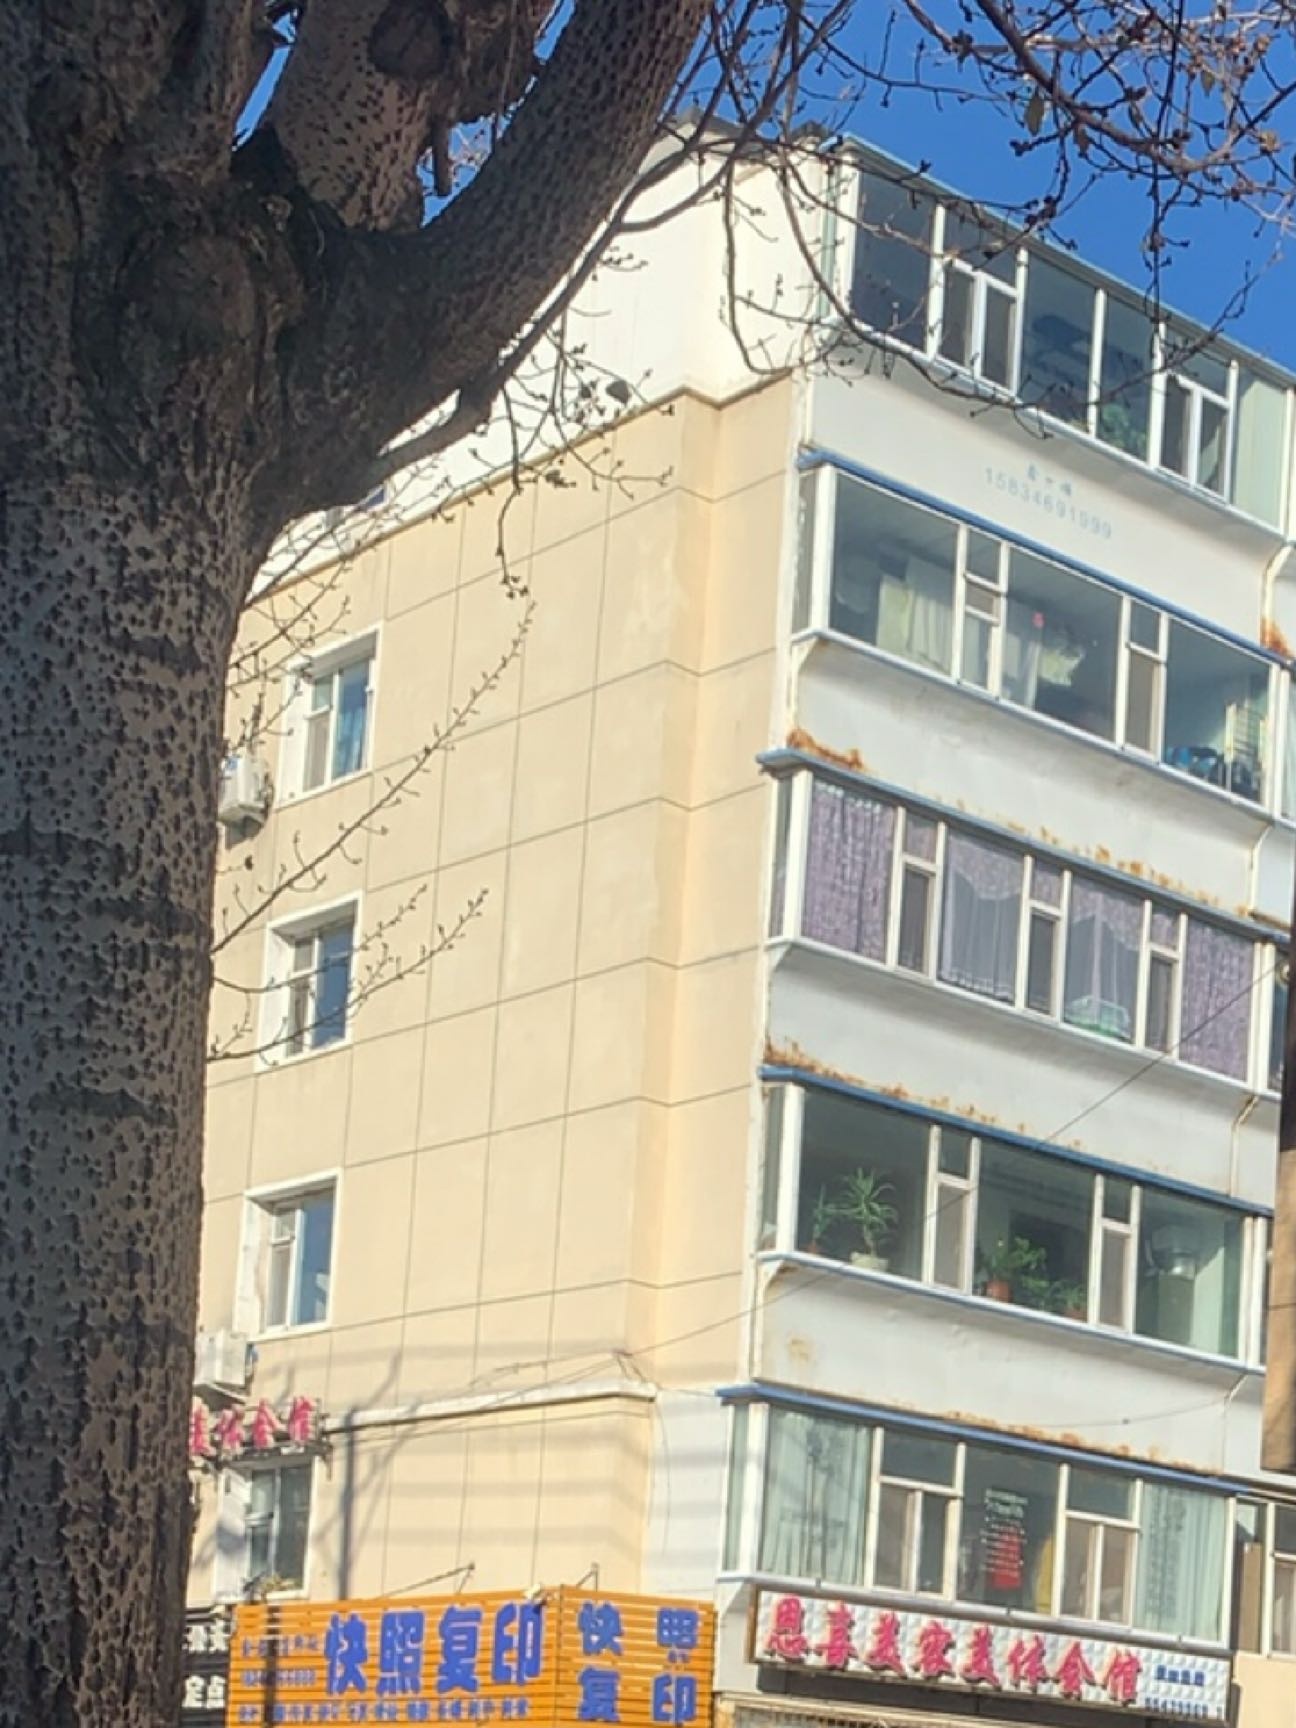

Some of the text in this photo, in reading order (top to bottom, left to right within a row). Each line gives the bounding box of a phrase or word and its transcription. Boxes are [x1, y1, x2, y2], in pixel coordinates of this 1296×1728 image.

[325, 1602, 545, 1696] 快照复印
[577, 1601, 701, 1657] 快照
[576, 1667, 698, 1727] 复印
